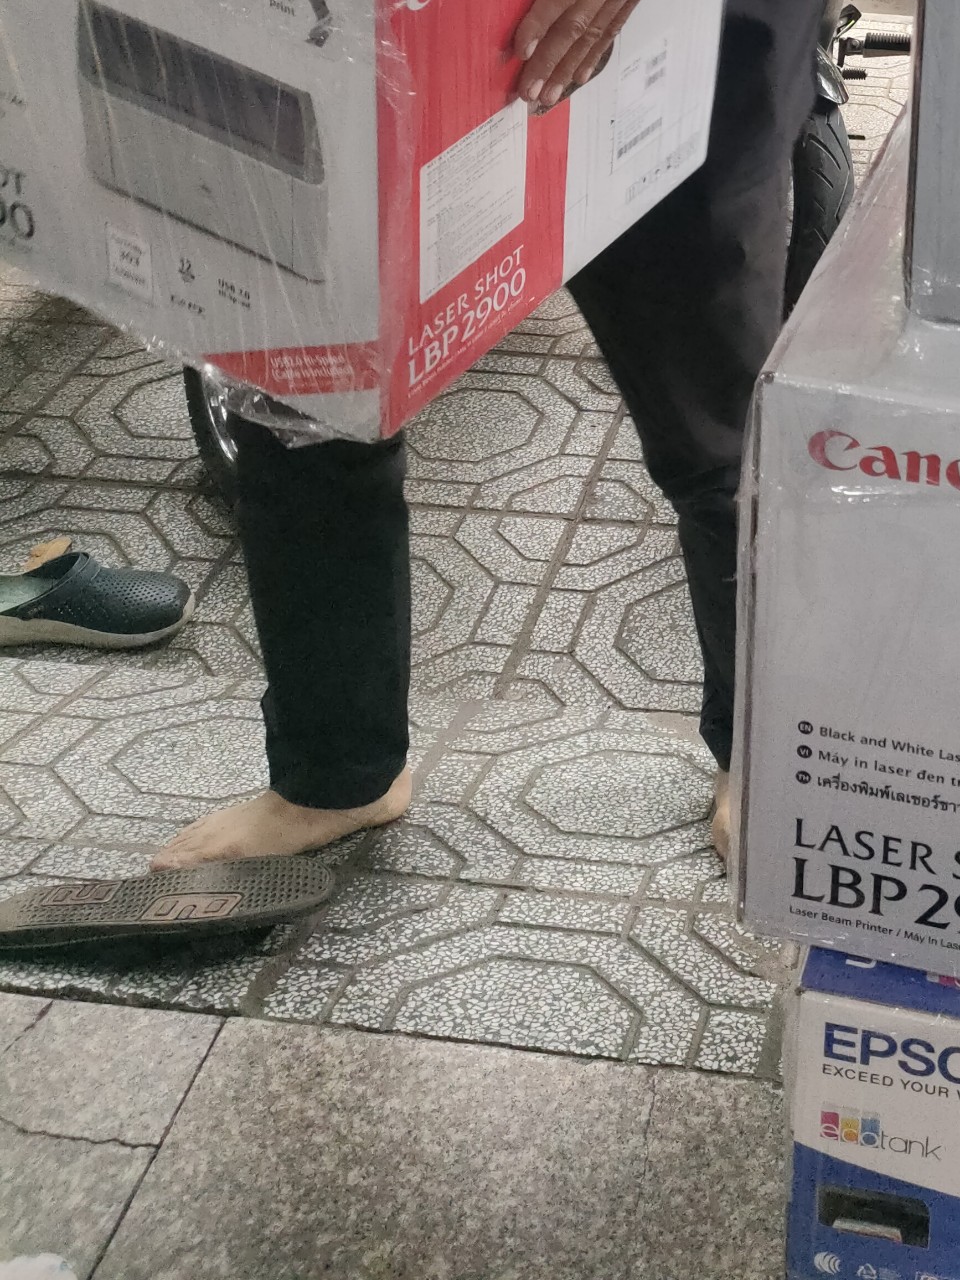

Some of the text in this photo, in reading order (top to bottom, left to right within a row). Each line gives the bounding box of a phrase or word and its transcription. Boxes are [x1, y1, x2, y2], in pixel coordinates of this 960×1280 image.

[407, 244, 525, 356] LASER SHOT
[407, 266, 528, 388] LBP 2900
[819, 726, 856, 742] Black
[860, 735, 887, 748] and
[891, 740, 934, 758] White
[818, 750, 849, 767] Máy
[854, 757, 868, 769] in
[874, 760, 912, 777] laser
[916, 769, 945, 784] đen
[794, 817, 937, 876] LASER
[791, 856, 908, 916] LBP
[790, 904, 817, 919] Laser
[821, 912, 852, 926] Beam
[855, 920, 894, 936] Printer
[822, 1063, 894, 1087] EXCEED
[900, 1078, 950, 1099] YOUR
